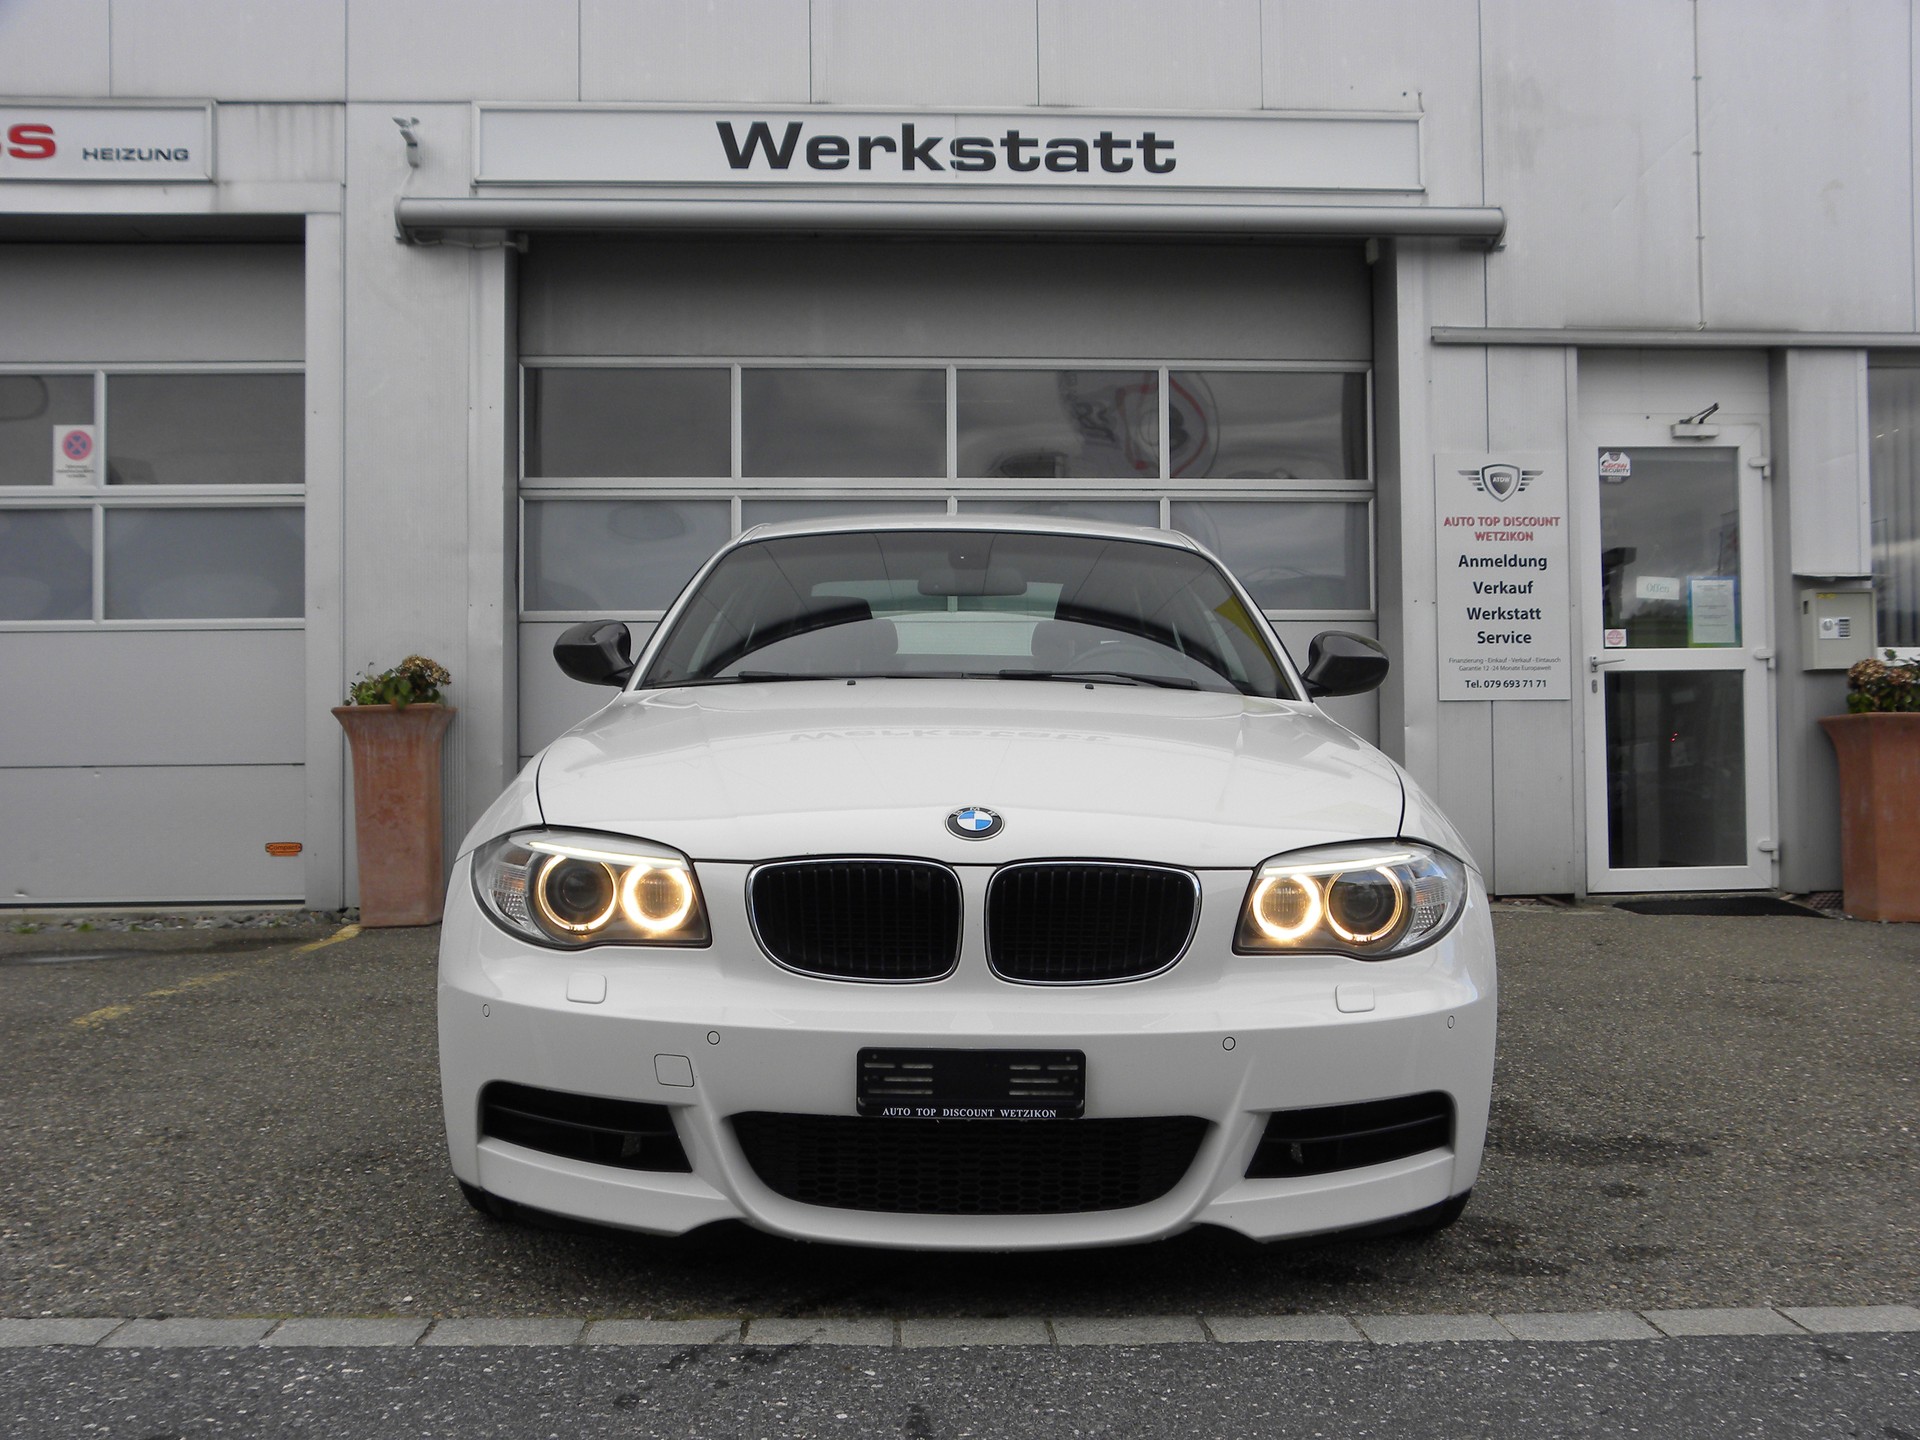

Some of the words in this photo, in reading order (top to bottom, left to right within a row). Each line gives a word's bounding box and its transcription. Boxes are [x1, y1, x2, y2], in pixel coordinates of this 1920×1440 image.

[716, 120, 1177, 174] Werkstatt
[82, 148, 189, 161] HEIZUNG
[1444, 516, 1475, 527] AUTO
[1478, 516, 1501, 527] TOP
[1503, 516, 1560, 527] DISCOUNT
[1475, 531, 1534, 542] WETZIKON
[1458, 553, 1548, 571] Anmeldung
[1473, 580, 1534, 594] Verkauf
[1466, 606, 1542, 620] Werkstatt
[1477, 630, 1532, 644] Service
[1448, 657, 1484, 665] Finanzierung
[1521, 664, 1552, 672] Europaweit
[1465, 680, 1482, 688] Tel.
[1483, 680, 1502, 688] 079
[1503, 680, 1520, 688] 693
[1522, 680, 1533, 688] 71
[1536, 680, 1547, 688] 71
[882, 1107, 911, 1116] AUTO
[916, 1107, 937, 1117] TOP
[943, 1108, 995, 1117] DISCOUNT
[1000, 1109, 1057, 1118] WETZIKON
